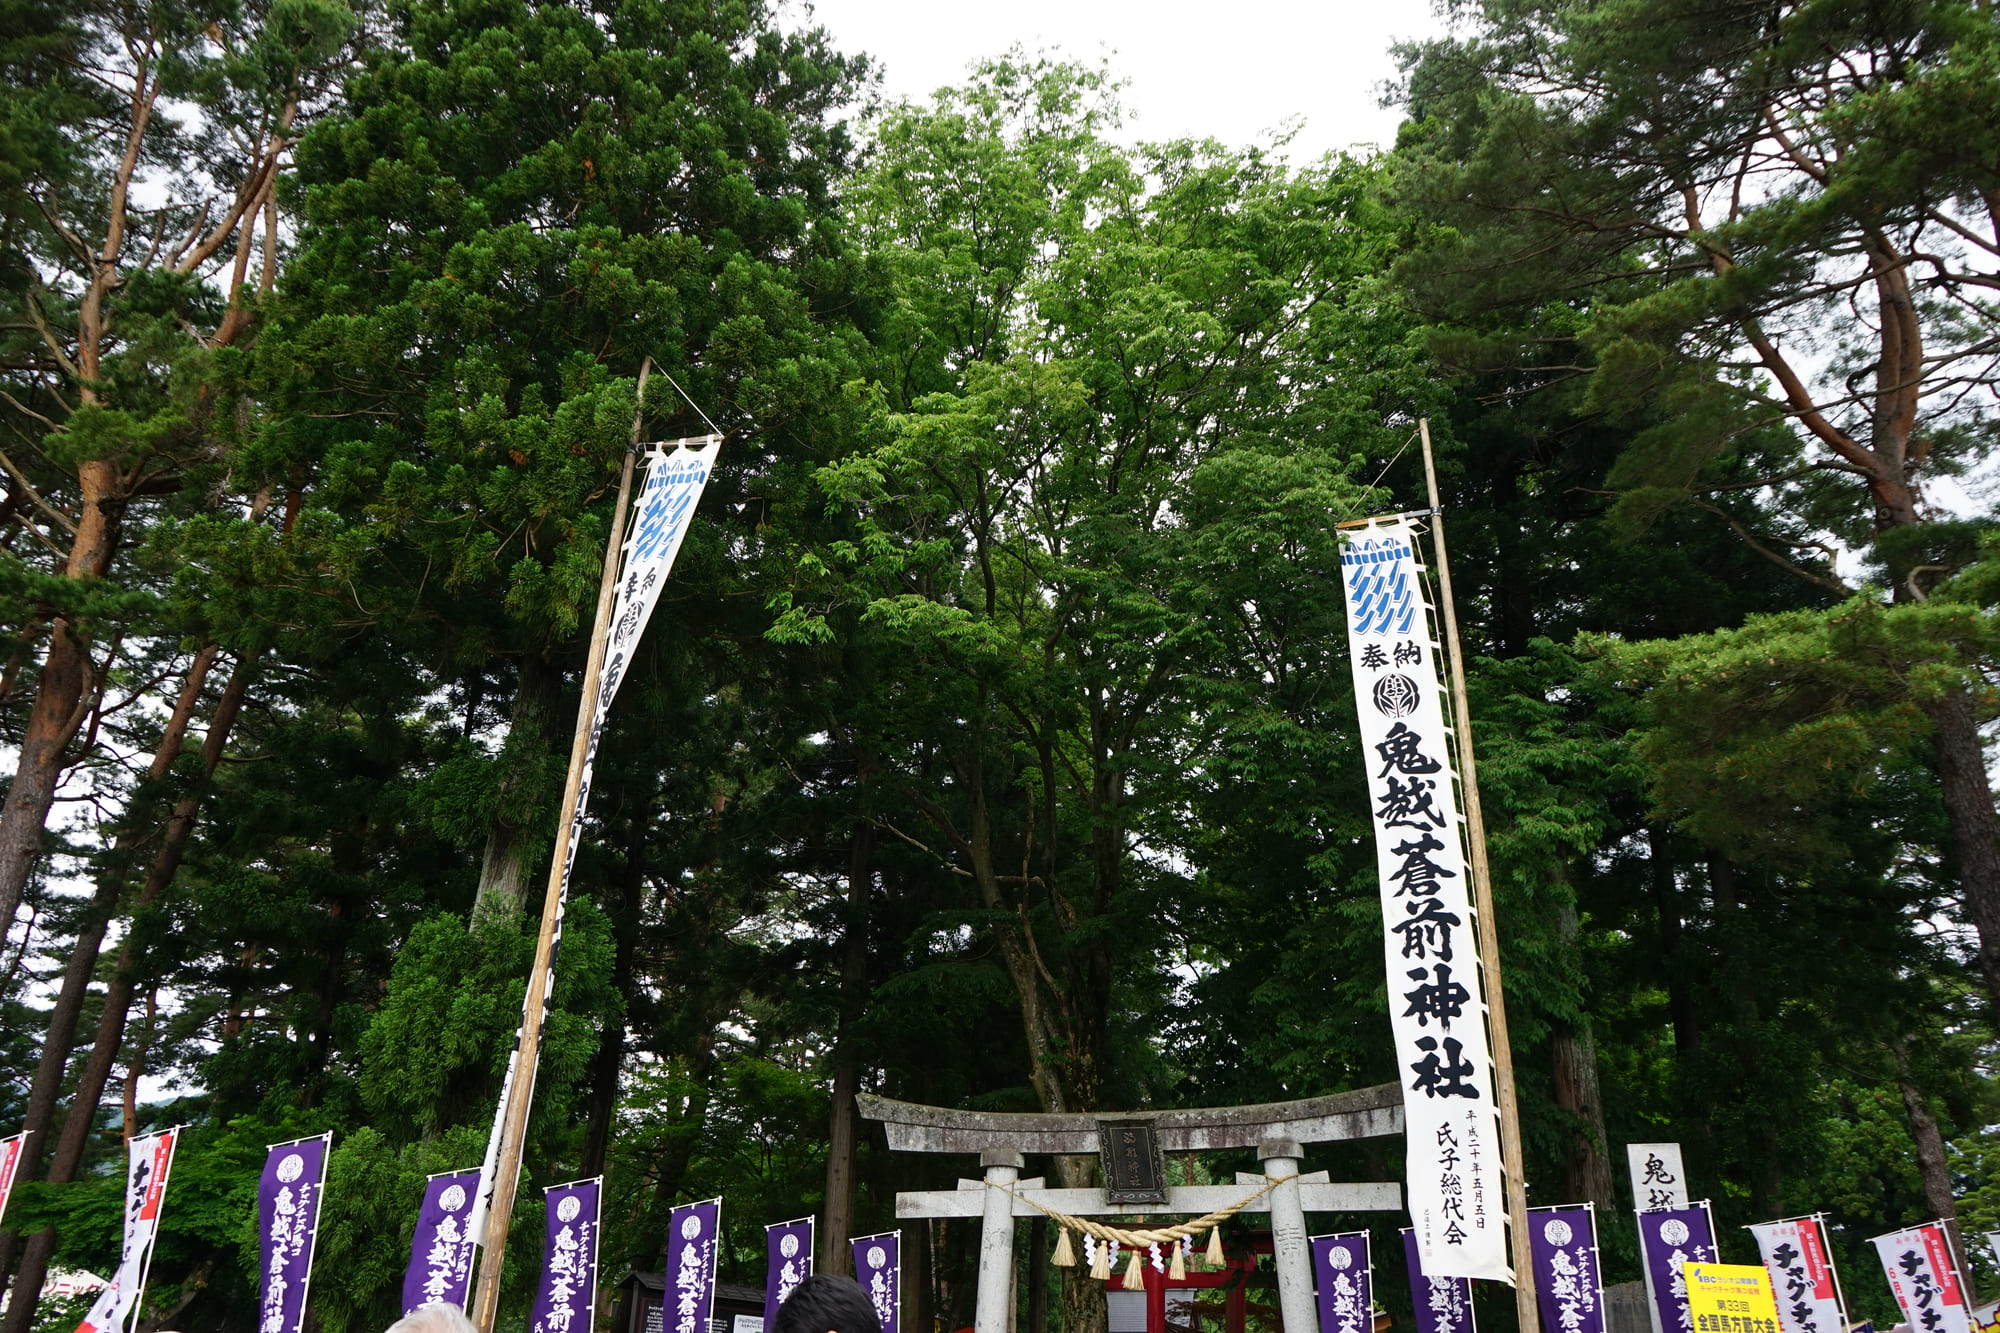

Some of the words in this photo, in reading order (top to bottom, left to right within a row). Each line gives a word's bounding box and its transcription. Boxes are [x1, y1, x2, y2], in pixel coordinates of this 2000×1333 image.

[1359, 641, 1423, 673] 奉納
[1373, 721, 1481, 1100] 鬼越蒼前神社
[1436, 1121, 1469, 1247] 氏子総代会
